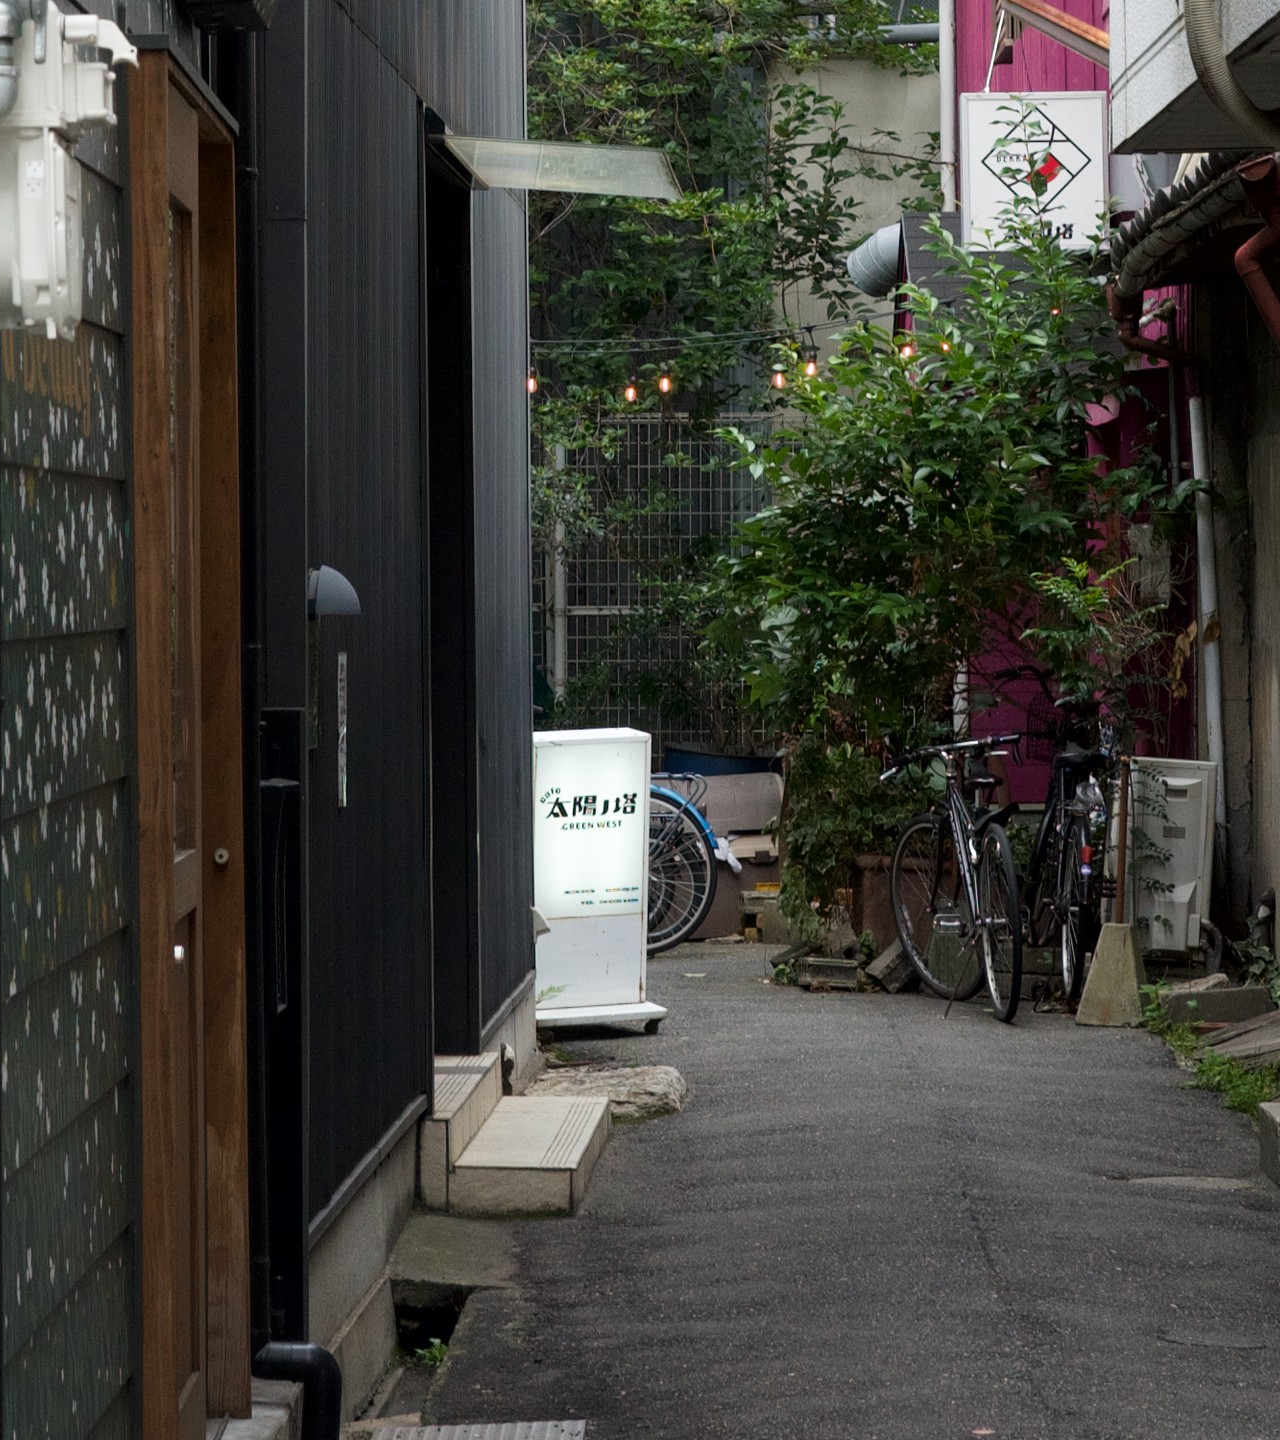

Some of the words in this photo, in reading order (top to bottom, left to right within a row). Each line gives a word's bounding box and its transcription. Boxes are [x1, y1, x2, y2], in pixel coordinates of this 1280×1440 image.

[540, 788, 561, 803] cafe
[546, 793, 637, 818] 太陽ノ塔
[561, 821, 594, 831] GREEN
[597, 820, 623, 829] WEST
